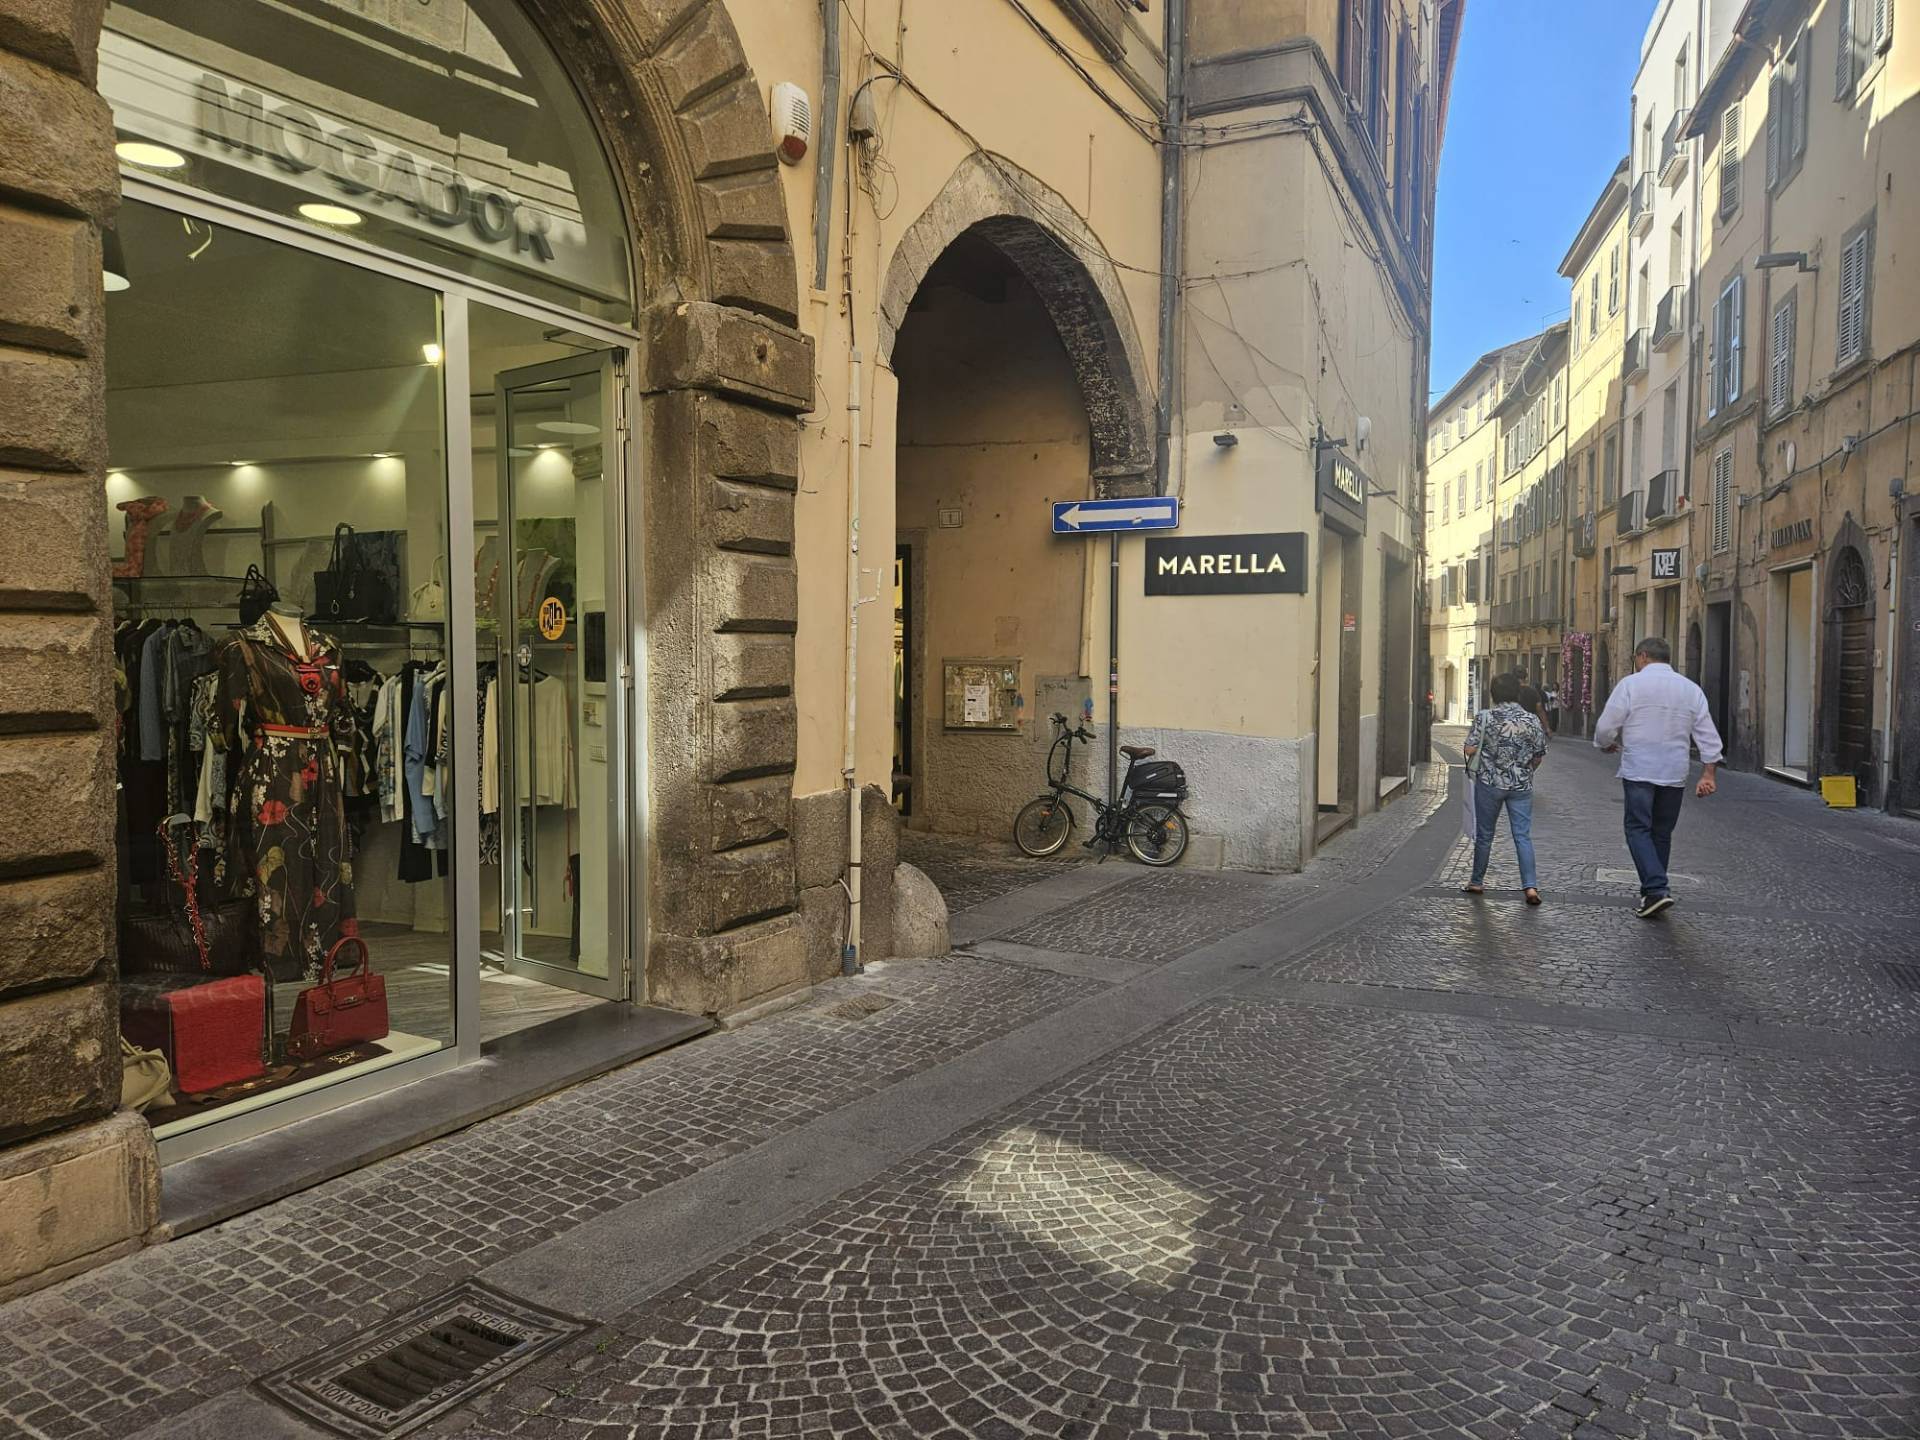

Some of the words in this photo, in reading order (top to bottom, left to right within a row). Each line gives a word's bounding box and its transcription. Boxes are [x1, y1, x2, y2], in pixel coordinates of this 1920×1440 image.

[192, 72, 554, 262] MOGADOR
[1335, 459, 1364, 505] MARELLA
[1158, 553, 1286, 576] MARELLA
[1653, 551, 1677, 565] TRY
[470, 1311, 534, 1338] OFFICINE
